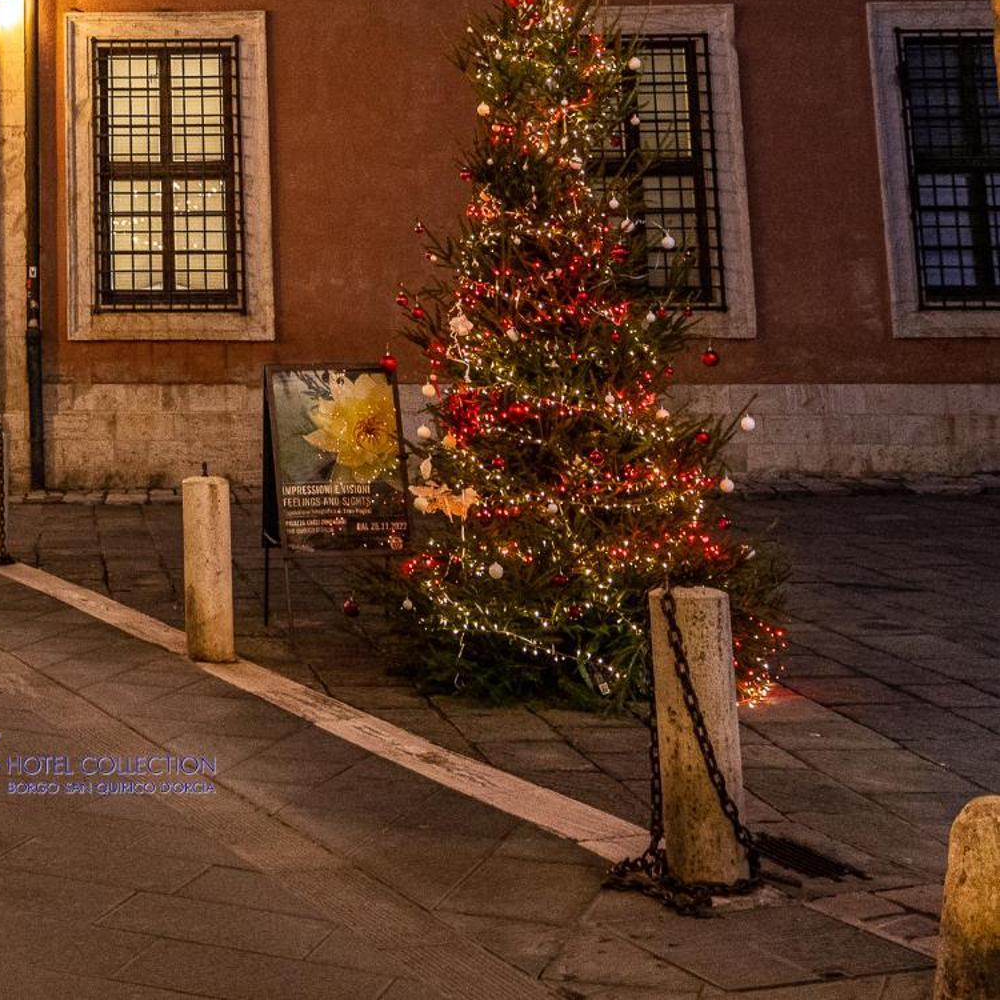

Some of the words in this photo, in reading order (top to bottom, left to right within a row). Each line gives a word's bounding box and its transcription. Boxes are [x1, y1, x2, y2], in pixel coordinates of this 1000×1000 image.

[282, 485, 333, 495] IMPRESSIONI
[335, 484, 341, 494] E
[341, 484, 371, 494] VISIONI
[283, 497, 321, 507] FEELINGS
[323, 497, 340, 506] AND
